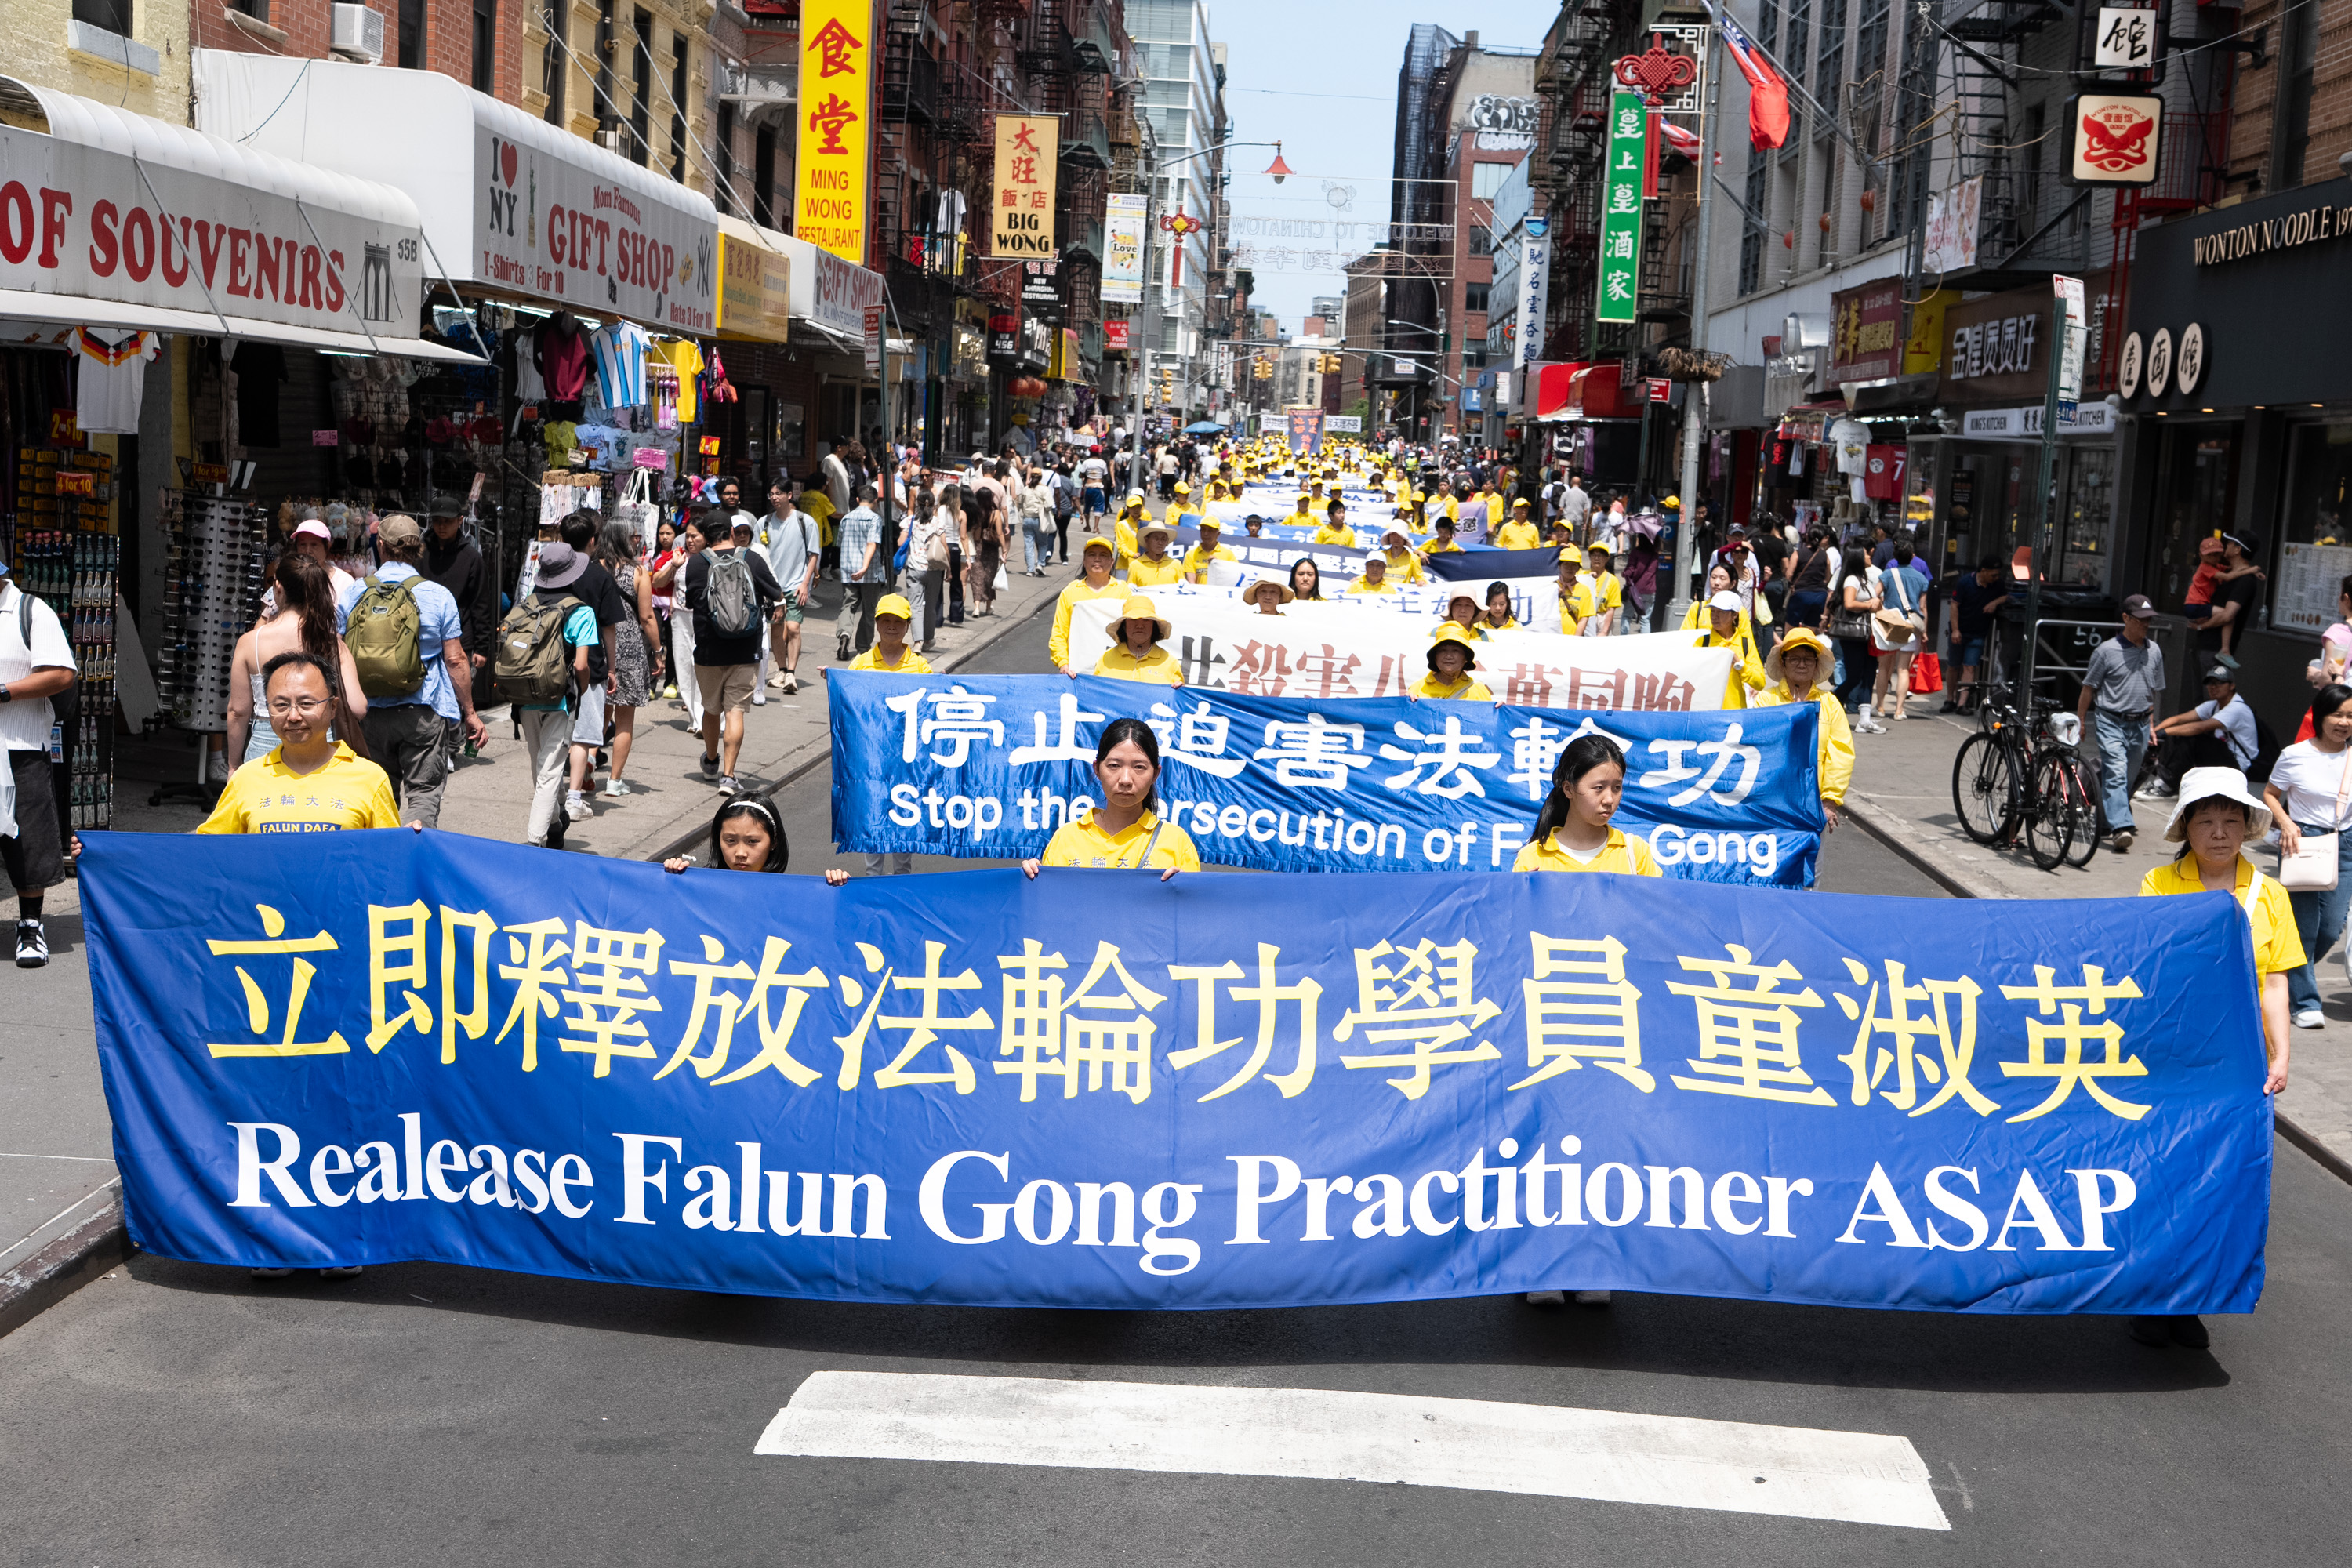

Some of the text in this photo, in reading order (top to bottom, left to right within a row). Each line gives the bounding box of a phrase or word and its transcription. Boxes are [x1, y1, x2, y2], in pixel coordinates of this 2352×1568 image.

[808, 18, 863, 155] 食堂
[2091, 104, 2147, 120] WONTON NOODLE
[1011, 122, 1039, 184] 大旺
[811, 169, 849, 191] MING
[593, 185, 641, 227] Mom Famous
[806, 198, 852, 220] WONG
[1001, 189, 1047, 209] 飯店
[489, 186, 517, 237] NY
[1007, 212, 1039, 230] BIG
[0, 180, 345, 313] OF SOUVENIRS
[797, 226, 861, 249] RESTAURANT
[997, 234, 1050, 252] WONG
[2194, 223, 2259, 267] WONTON
[2260, 205, 2332, 252] NOODLE
[547, 204, 611, 277] GIFT
[617, 227, 675, 295] SHOP
[1113, 243, 1138, 253] Love
[483, 250, 525, 285] T-Shirts
[536, 265, 552, 292] For
[554, 270, 564, 295] 10
[823, 256, 851, 307] GIFT
[851, 268, 879, 313] SHOP
[1025, 285, 1054, 293] SHANGHAI
[1021, 292, 1058, 301] RESTAURANT
[670, 303, 686, 325] Hats
[687, 306, 692, 326] 3
[693, 308, 704, 328] For
[705, 311, 712, 331] 10
[995, 339, 1014, 350] 456
[51, 412, 60, 439] 2
[1970, 416, 2008, 430] KING'S KITCHEN
[2078, 409, 2107, 426] KITCHEN
[699, 437, 706, 453] 3
[708, 439, 720, 456] $10
[74, 455, 96, 465] AARON
[198, 465, 210, 476] for
[1893, 459, 1904, 481] 7
[57, 477, 92, 492] 4 for 10
[1663, 525, 1672, 538] P
[886, 685, 1762, 808] 停止迫害法輪功
[260, 793, 344, 810] 法輪大法
[262, 823, 336, 834] FALUN DAFA
[888, 783, 1003, 841] Stop
[1017, 786, 1096, 831] the
[1156, 797, 1406, 861] ersecution
[1423, 821, 1478, 866] of
[1649, 824, 1777, 877] Gong
[208, 898, 2153, 1123] 立即釋放法輪功學員童淑英
[227, 1112, 2137, 1276] Realease Falun Gong Practitioner ASAP
